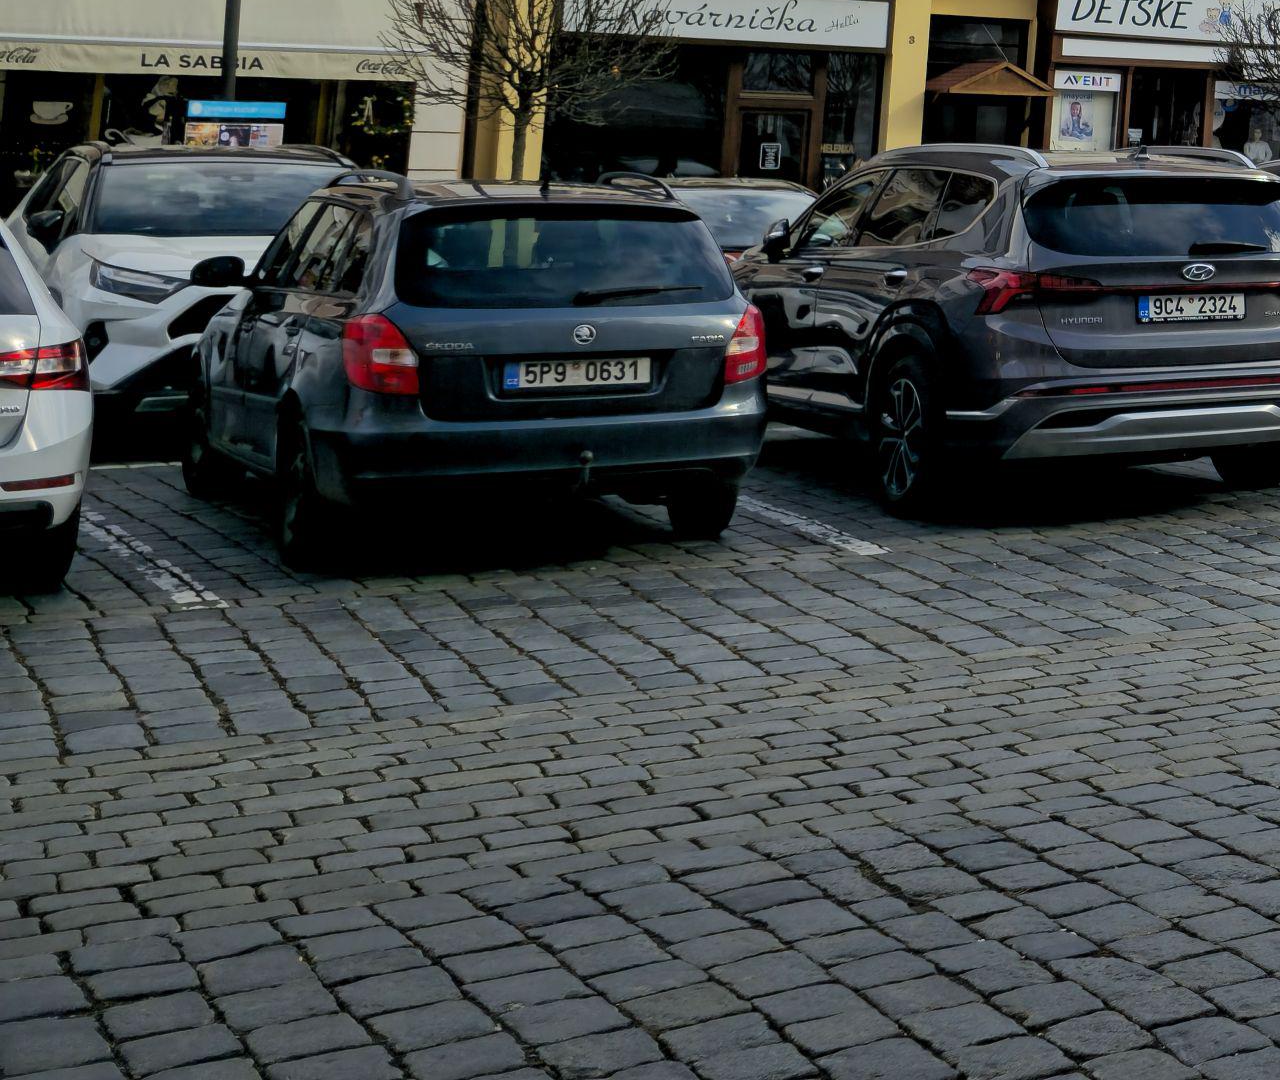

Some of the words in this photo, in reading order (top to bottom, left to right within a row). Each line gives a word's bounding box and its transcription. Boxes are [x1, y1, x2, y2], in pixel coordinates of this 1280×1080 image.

[140, 53, 170, 69] LA
[178, 54, 265, 71] SABIA
[1063, 74, 1113, 88] AVENT
[1153, 298, 1185, 316] 9C4
[1197, 296, 1237, 315] 2324
[1061, 316, 1103, 325] HYUNDAI
[524, 361, 567, 385] 5P9
[584, 359, 639, 382] 0631
